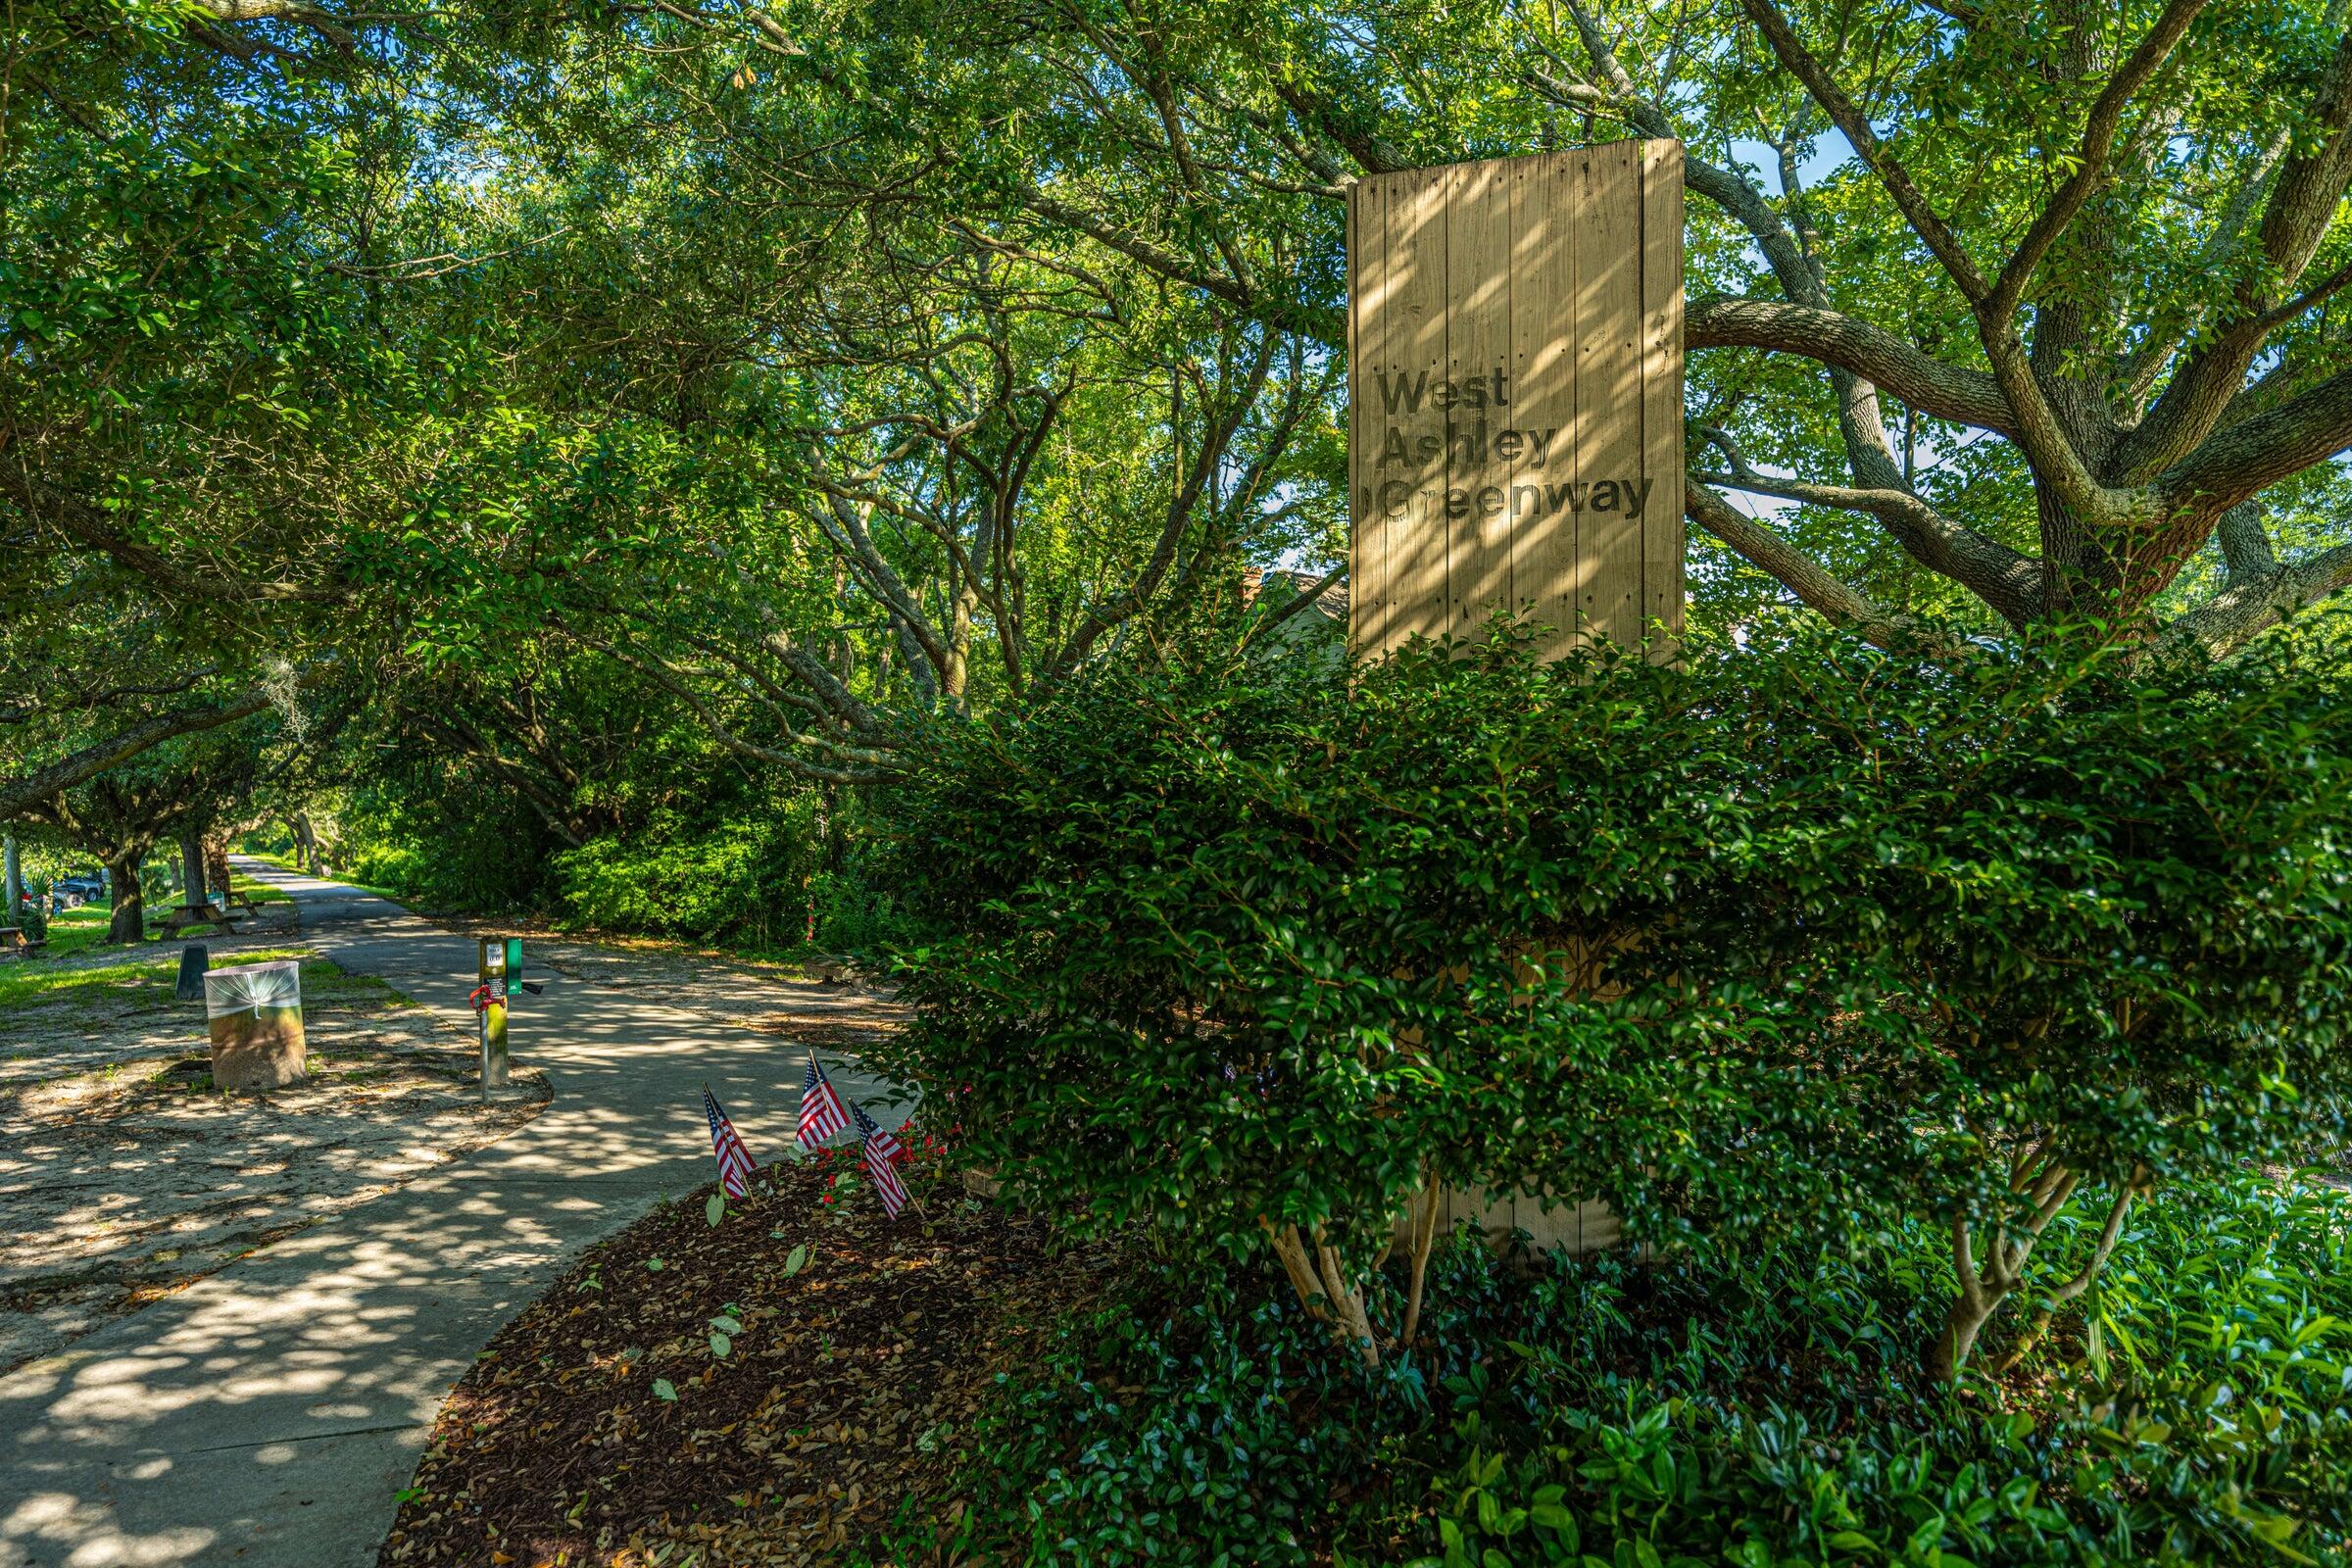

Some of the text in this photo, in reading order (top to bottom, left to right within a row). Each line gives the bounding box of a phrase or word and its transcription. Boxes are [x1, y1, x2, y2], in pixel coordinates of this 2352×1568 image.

[1376, 368, 1509, 416] West
[1376, 418, 1556, 469] Ashley
[1378, 477, 1654, 522] Greenway
